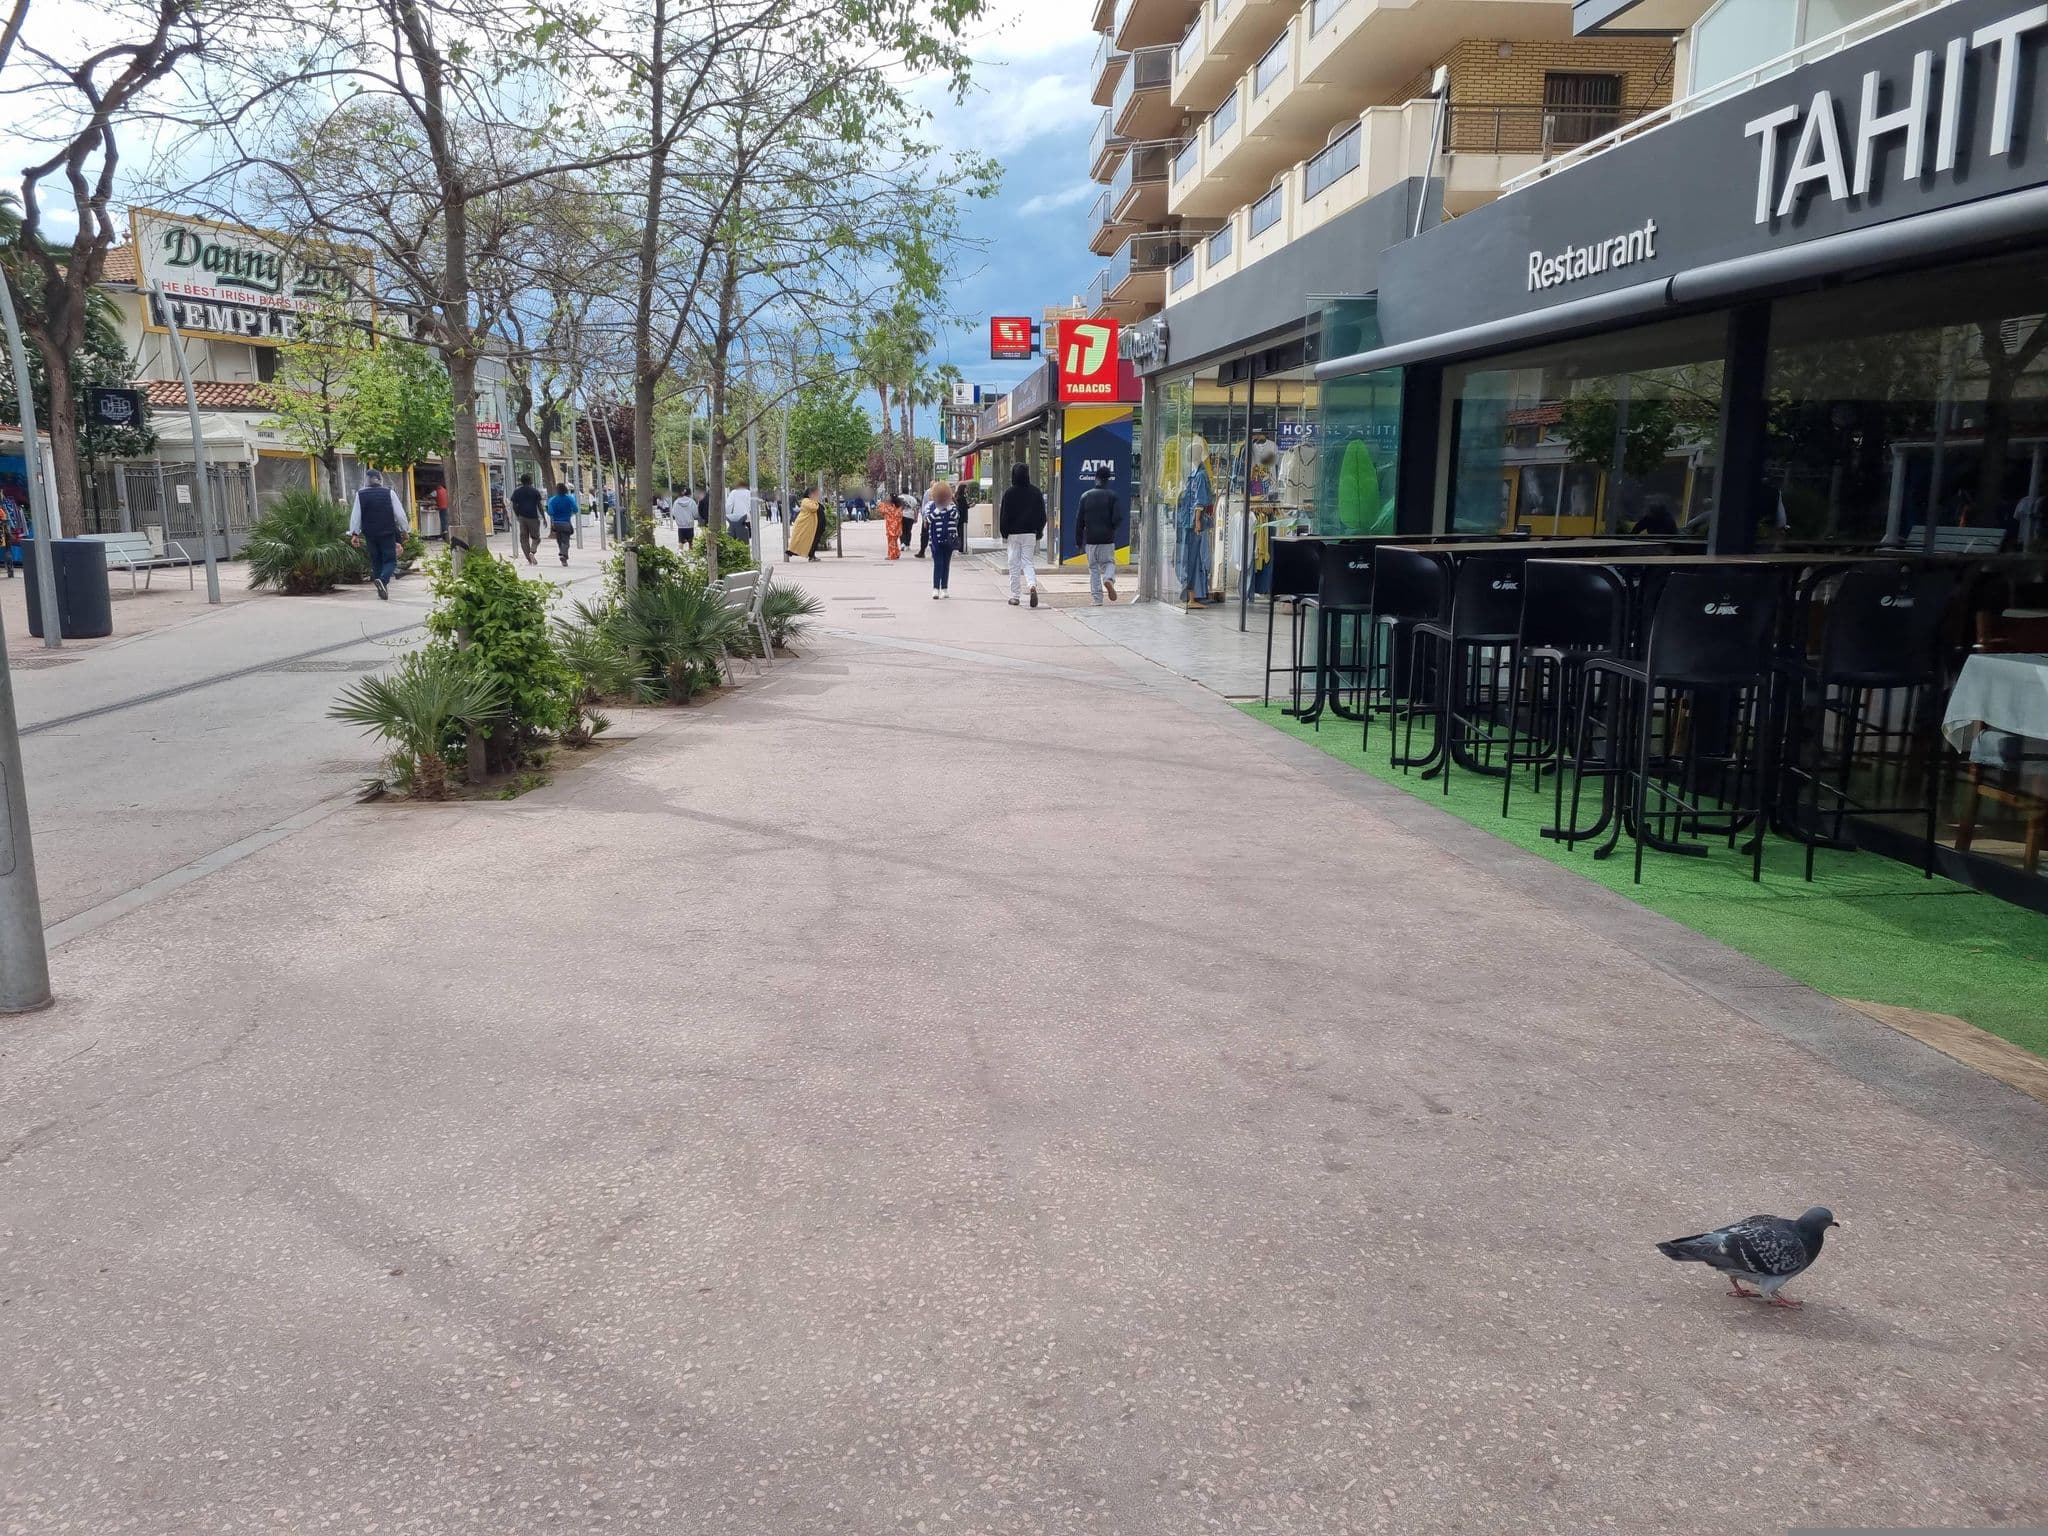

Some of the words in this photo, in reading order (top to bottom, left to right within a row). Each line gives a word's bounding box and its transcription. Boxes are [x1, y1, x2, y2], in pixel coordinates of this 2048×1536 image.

[164, 225, 283, 294] Danny
[1527, 218, 1657, 292] Restaurant
[184, 284, 217, 297] BEST
[222, 289, 255, 303] IRISH
[260, 295, 291, 309] BARS
[1066, 383, 1112, 393] TABACOS
[1081, 459, 1115, 472] ATM
